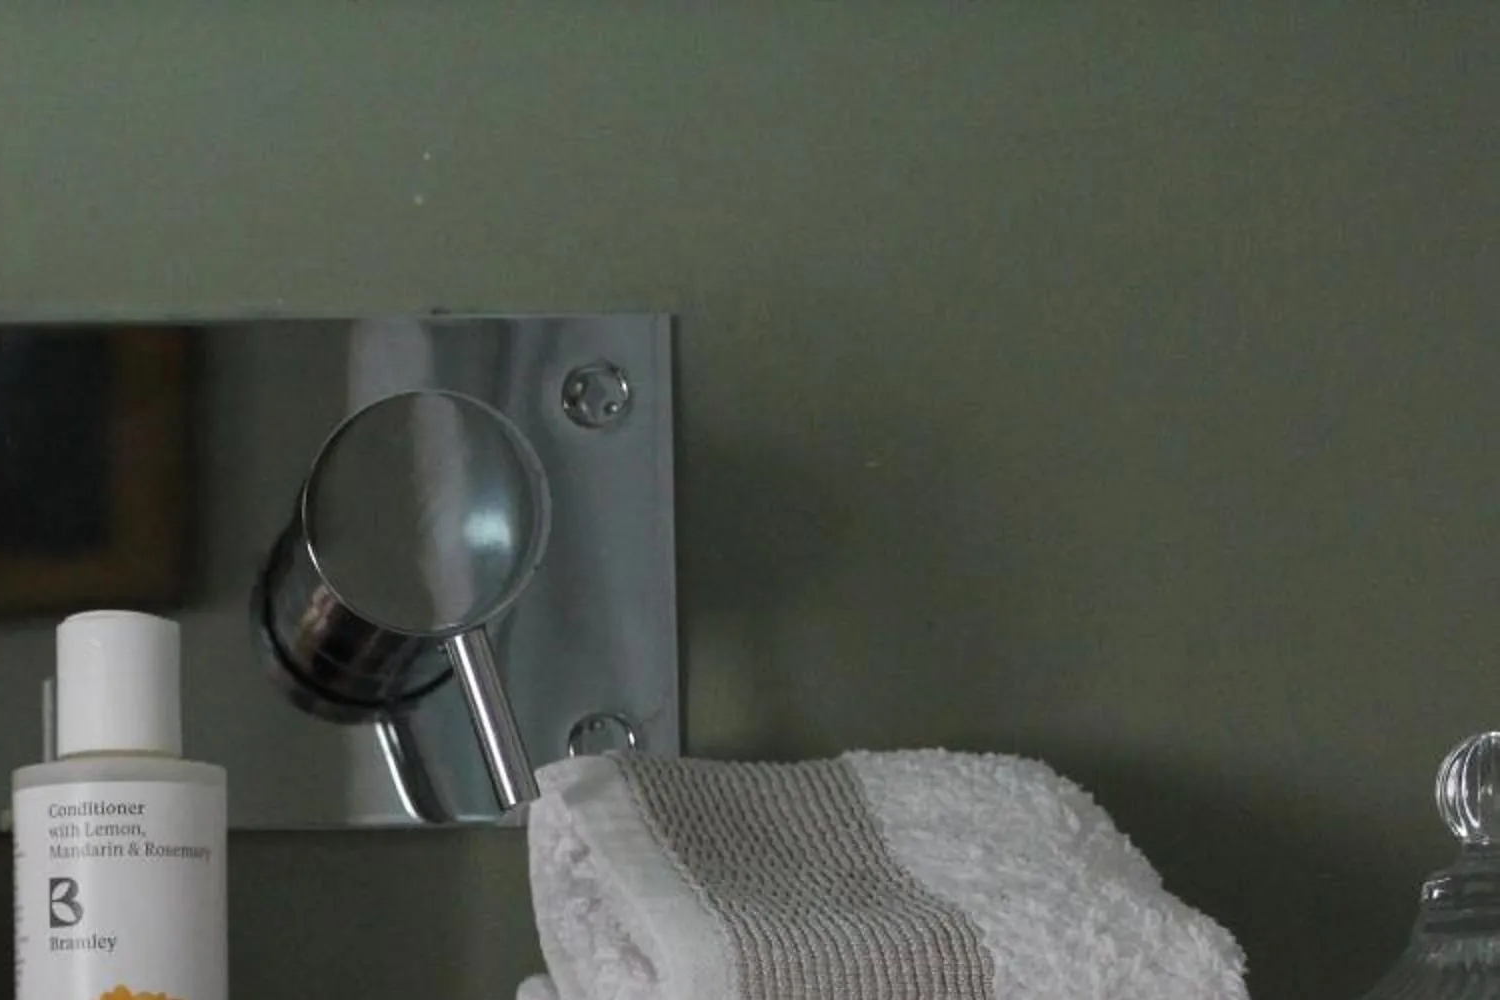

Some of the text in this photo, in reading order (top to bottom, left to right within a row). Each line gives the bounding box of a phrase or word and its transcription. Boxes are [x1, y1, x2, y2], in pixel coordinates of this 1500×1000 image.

[48, 801, 146, 819] Conditioner
[49, 822, 146, 839] with Lemon,
[49, 842, 210, 863] Mandarin & Rosemary
[49, 877, 84, 928] B
[49, 932, 118, 952] Bramley
